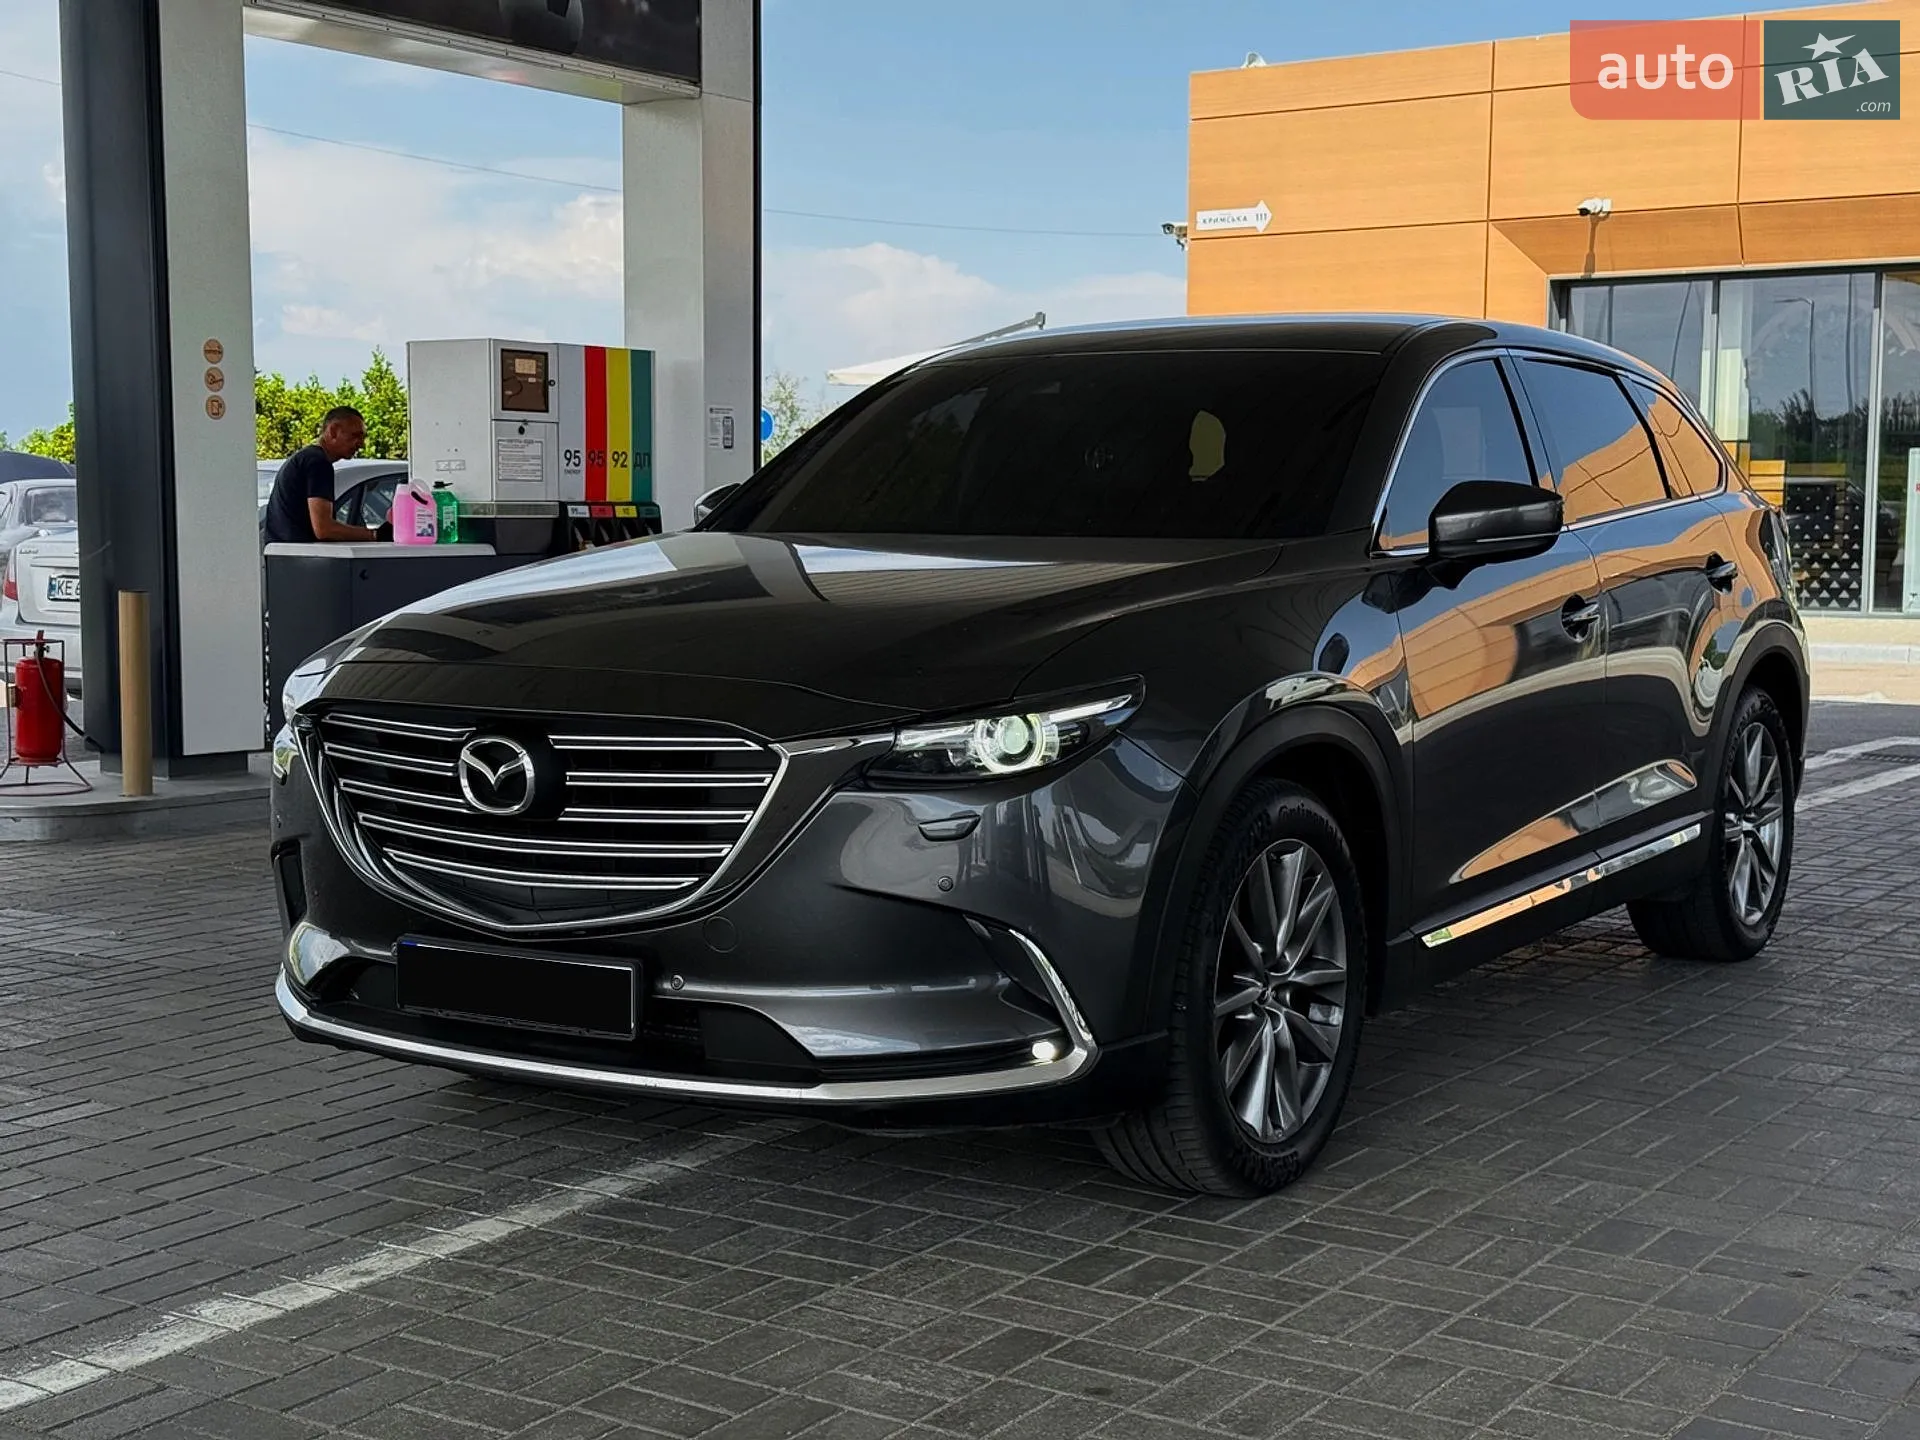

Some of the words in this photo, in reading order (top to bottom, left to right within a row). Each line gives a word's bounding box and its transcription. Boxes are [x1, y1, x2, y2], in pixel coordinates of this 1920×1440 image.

[1202, 215, 1248, 224] КРИМСЬКА
[1255, 212, 1267, 222] 111
[564, 449, 581, 467] 95
[588, 450, 605, 467] 95
[612, 451, 628, 468] 92
[633, 452, 651, 469] ДП
[57, 580, 73, 596] KE
